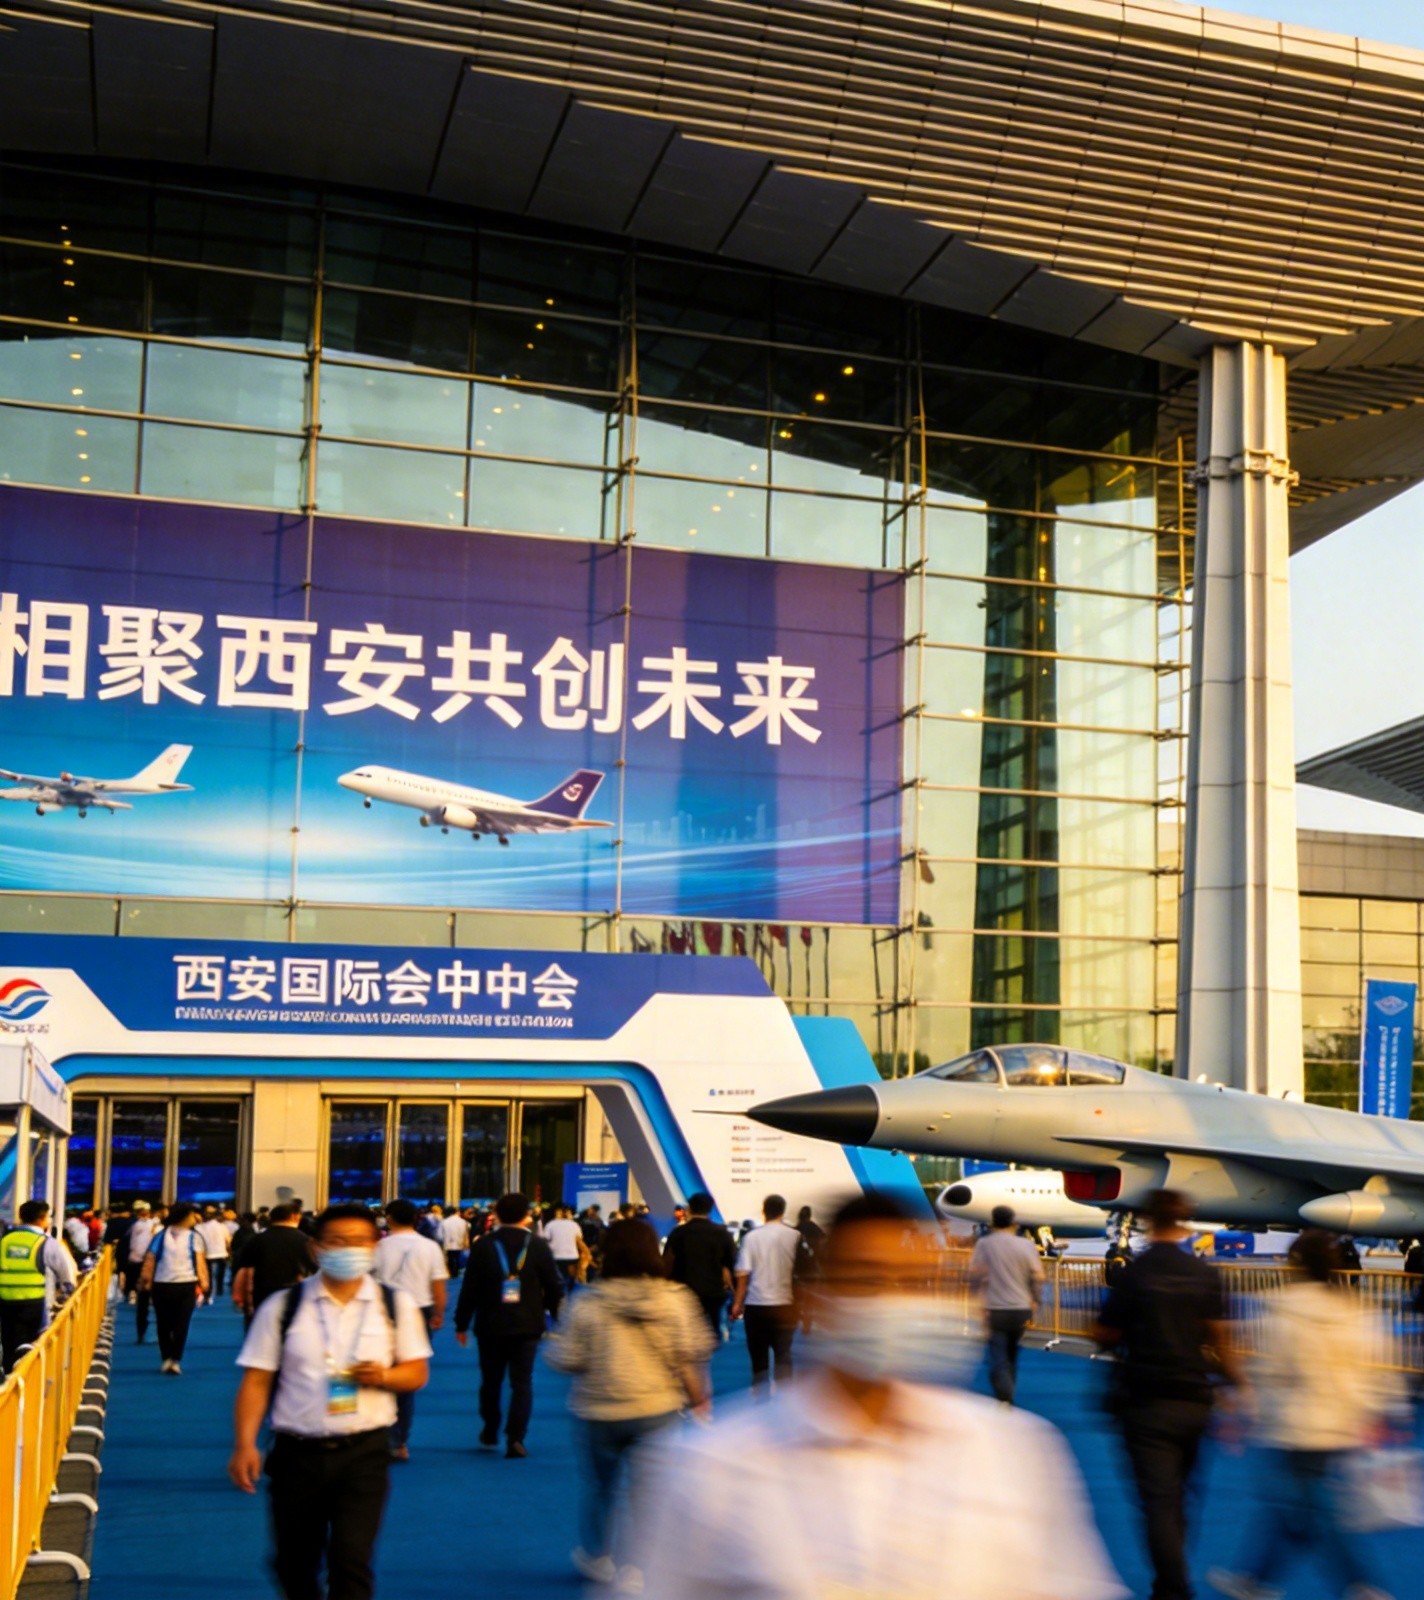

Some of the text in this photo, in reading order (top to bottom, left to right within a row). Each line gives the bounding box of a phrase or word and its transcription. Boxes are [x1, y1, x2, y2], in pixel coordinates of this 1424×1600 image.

[0, 592, 823, 746] 相聚西安共创未来
[172, 954, 579, 1010] 西安国际会中中会
